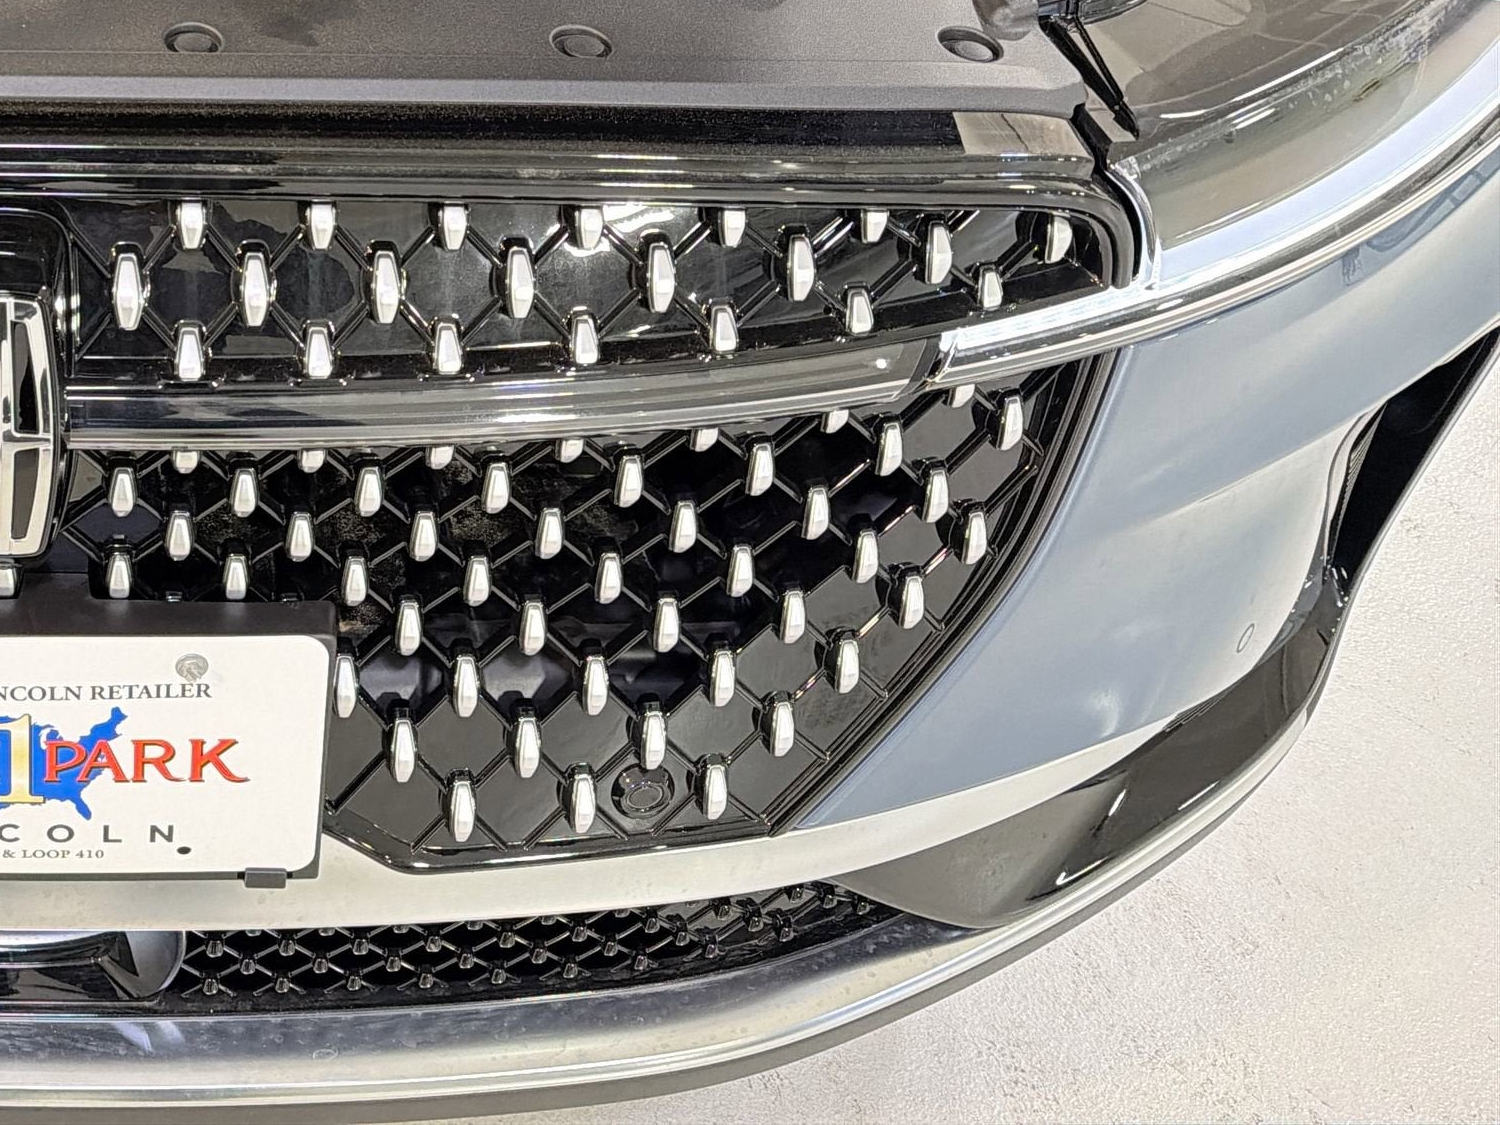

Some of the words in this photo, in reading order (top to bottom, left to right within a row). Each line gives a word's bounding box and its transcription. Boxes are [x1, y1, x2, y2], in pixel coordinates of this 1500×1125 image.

[89, 683, 213, 701] RETAILER
[43, 737, 251, 783] PARK
[3, 849, 16, 859] &
[21, 849, 71, 859] LOOP
[75, 849, 105, 859] 410
